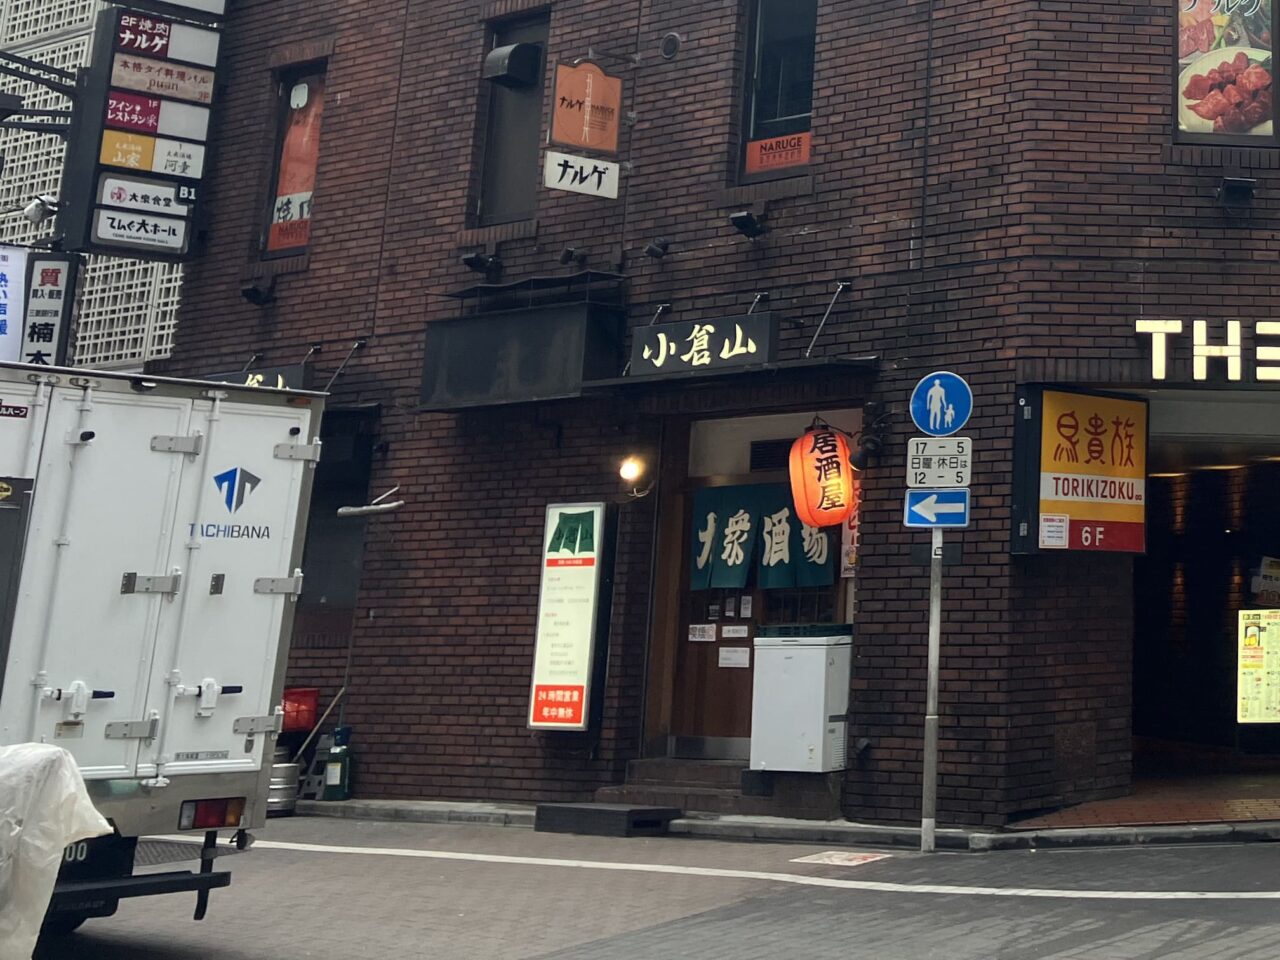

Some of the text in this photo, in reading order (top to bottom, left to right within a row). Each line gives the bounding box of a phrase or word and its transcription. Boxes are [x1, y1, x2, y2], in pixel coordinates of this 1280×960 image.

[121, 15, 169, 36] 2F 焼肉
[120, 29, 168, 53] ナルゲ
[108, 99, 133, 112] ワイン
[760, 136, 803, 153] NARUGE
[557, 159, 609, 191] ナルゲ
[179, 186, 196, 200] B1
[106, 216, 178, 237] てんぐ大ホール
[39, 268, 61, 287] 質
[642, 323, 757, 368] 小倉山
[915, 442, 927, 455] 17
[956, 442, 964, 454] 5
[1053, 410, 1135, 468] 鳥貴族
[810, 431, 846, 511] 居酒屋
[911, 457, 968, 470] 日曜・休日は
[914, 472, 926, 485] 12
[955, 471, 963, 484] 5
[1053, 476, 1134, 501] TORIKIZOKU
[1081, 526, 1104, 546] 6F
